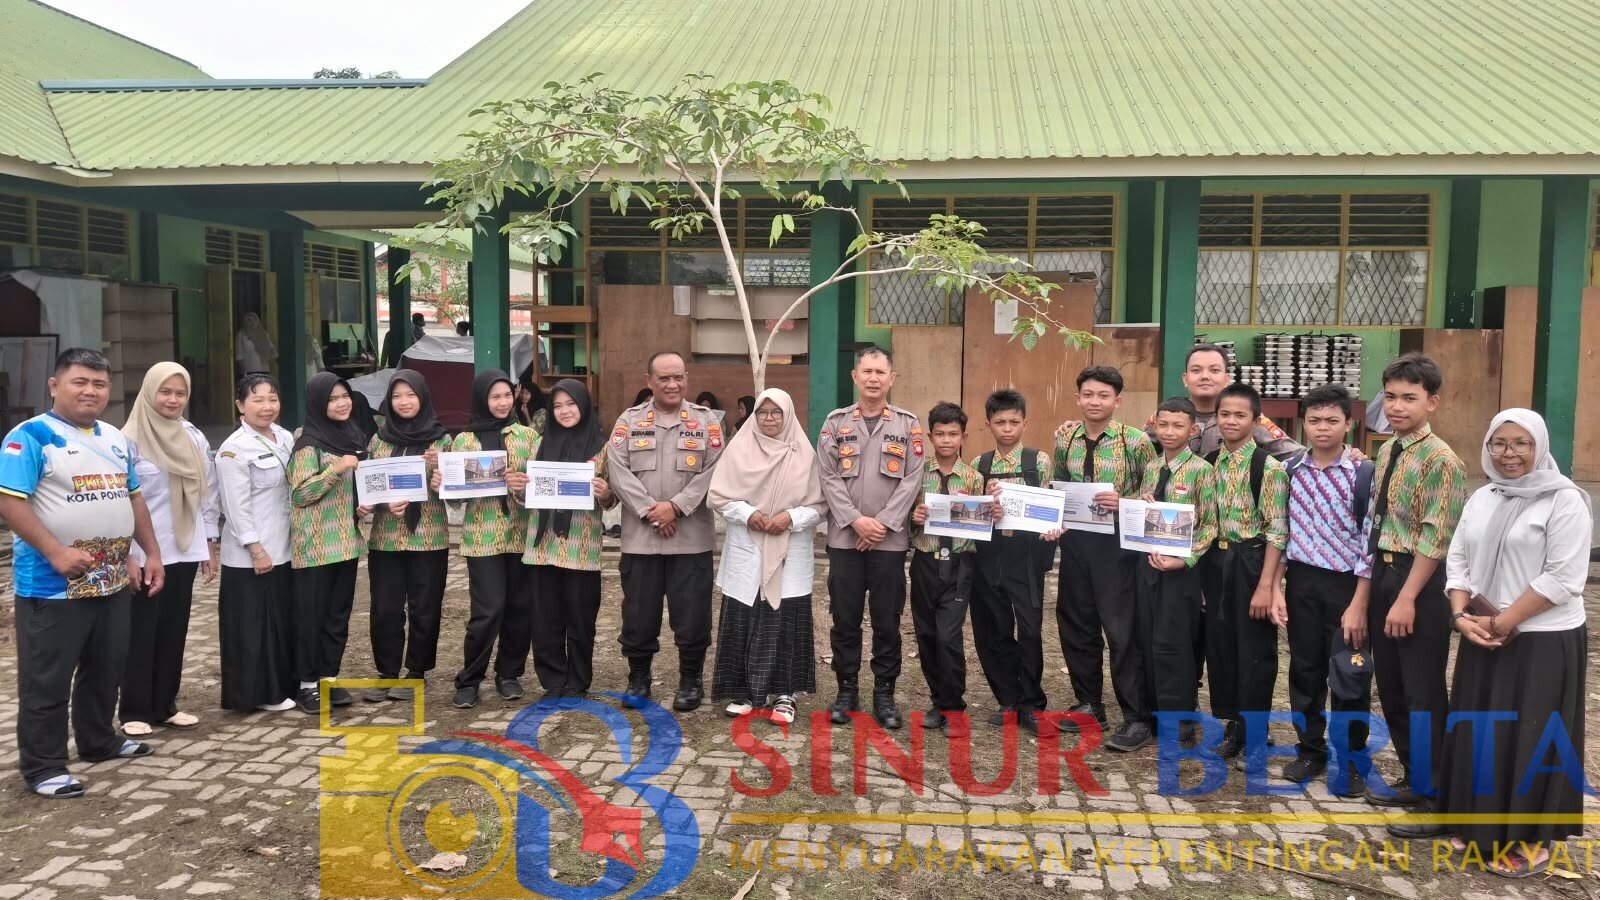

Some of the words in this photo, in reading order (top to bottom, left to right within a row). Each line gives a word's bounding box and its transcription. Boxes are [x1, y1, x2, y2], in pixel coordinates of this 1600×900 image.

[883, 434, 908, 445] POLRI
[72, 474, 105, 493] PKG
[66, 492, 99, 503] KOTA
